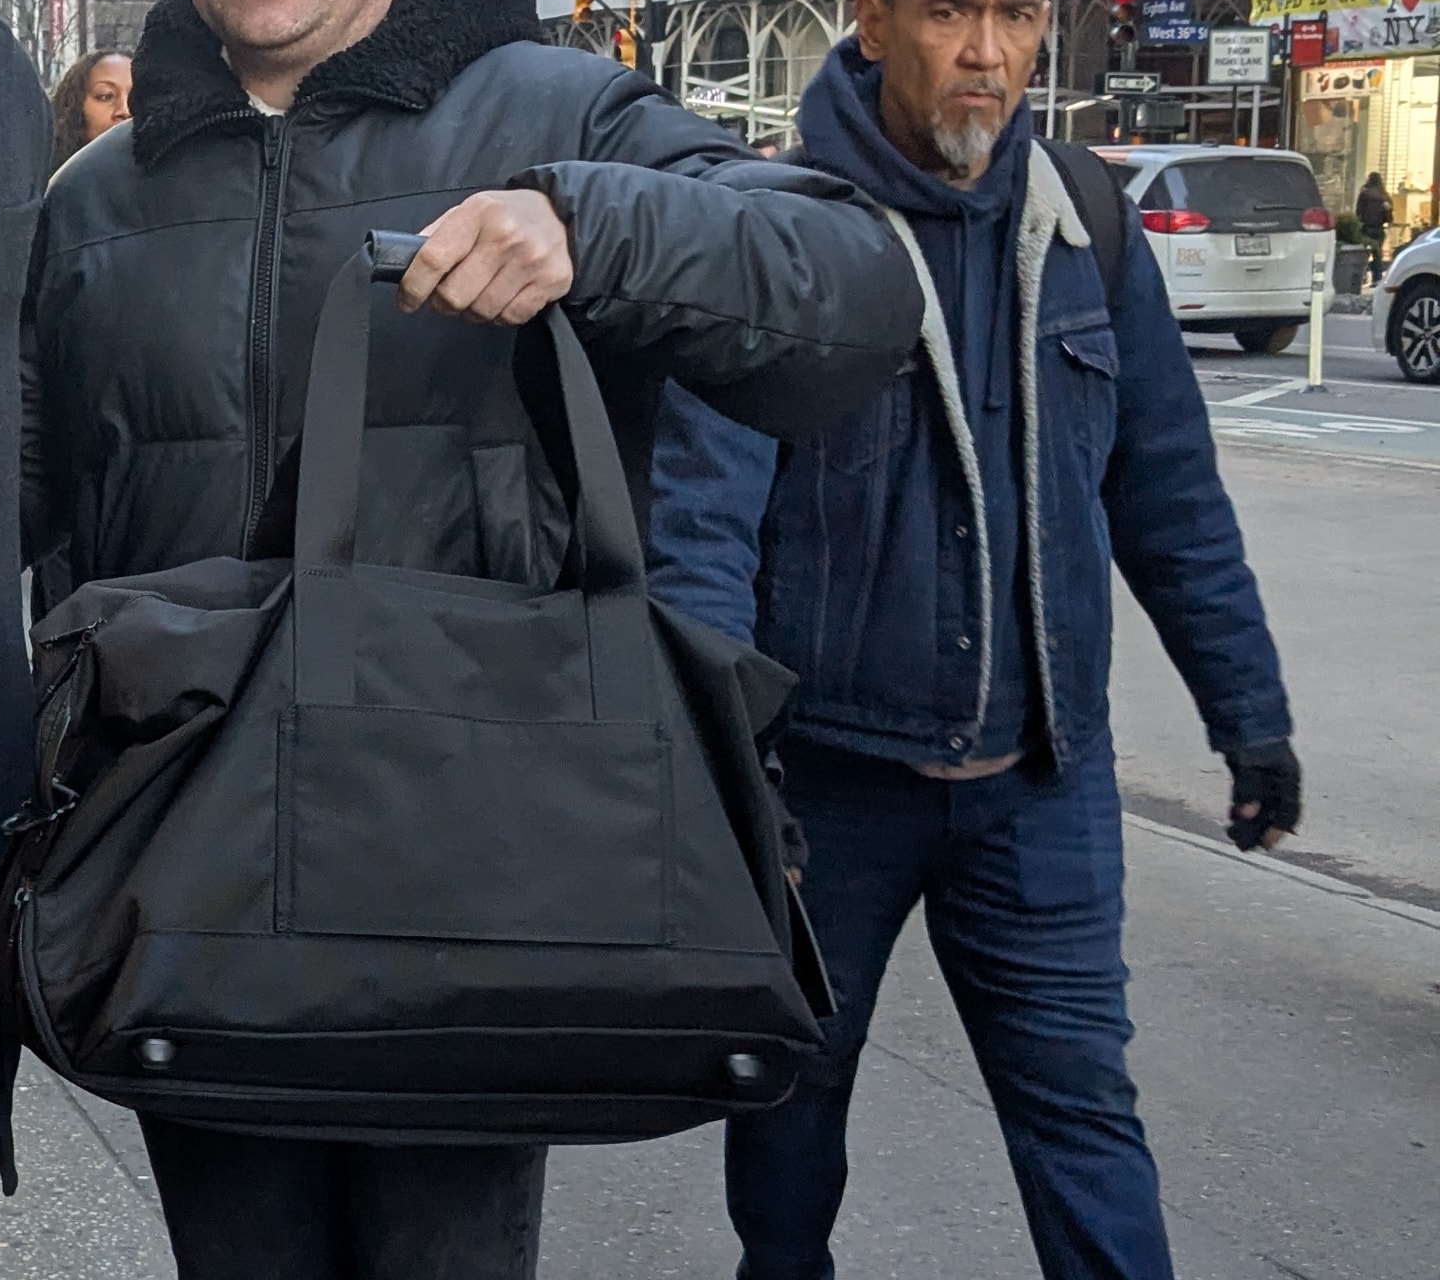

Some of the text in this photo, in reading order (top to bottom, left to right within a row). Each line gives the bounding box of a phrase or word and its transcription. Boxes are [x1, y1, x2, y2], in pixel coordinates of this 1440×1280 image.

[1169, 0, 1185, 12] Ave
[1148, 26, 1175, 39] West
[1383, 15, 1425, 46] NY
